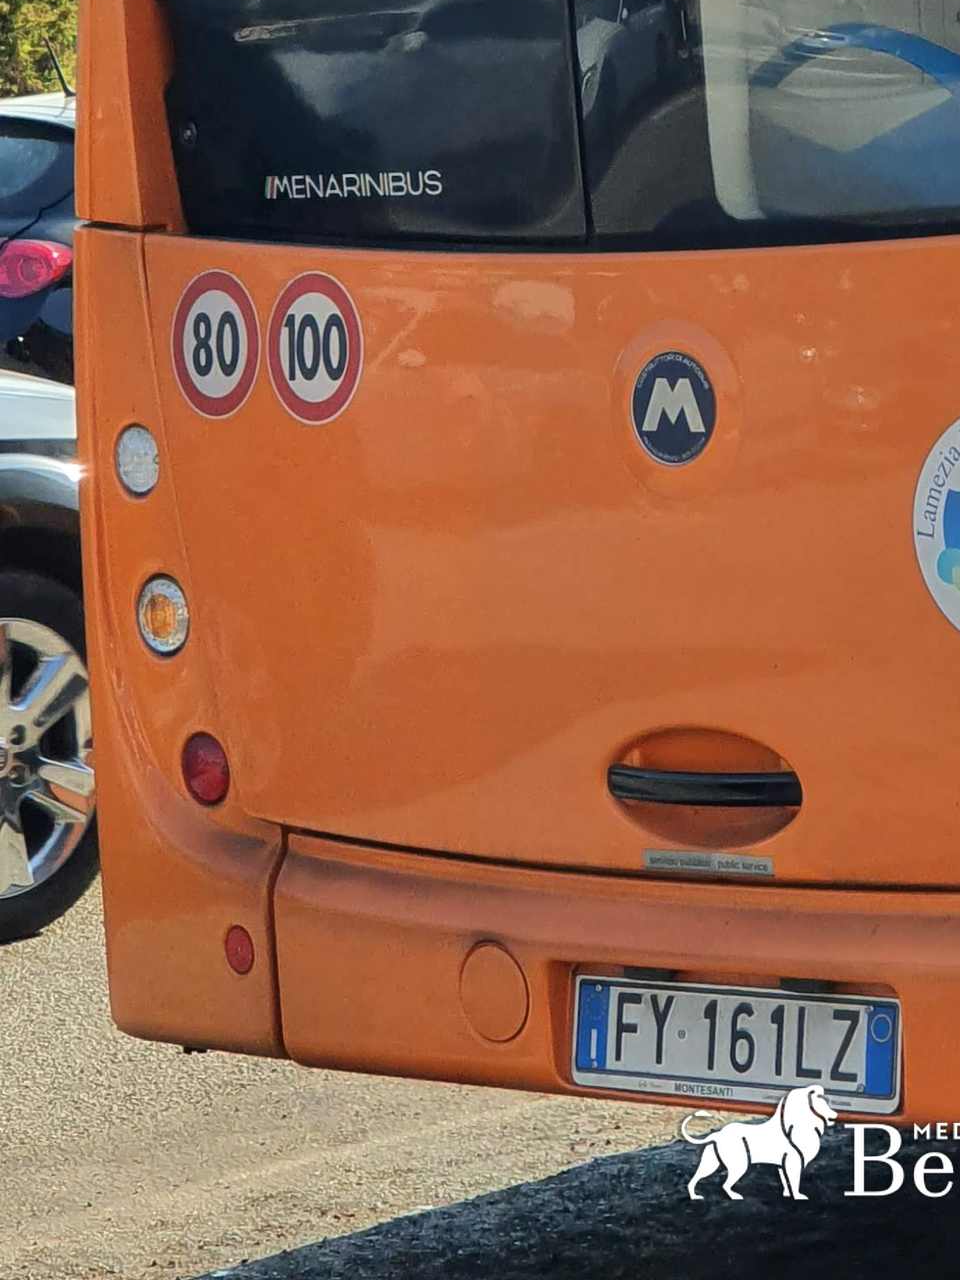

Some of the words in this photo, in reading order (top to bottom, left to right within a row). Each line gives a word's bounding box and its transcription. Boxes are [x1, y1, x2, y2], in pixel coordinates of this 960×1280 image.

[267, 170, 443, 200] MENARINIBUS
[192, 311, 240, 377] 80
[284, 313, 348, 381] 100
[642, 377, 706, 433] M
[614, 991, 675, 1065] FY
[703, 998, 861, 1083] 161LZ
[674, 1082, 734, 1098] MONTESANTI
